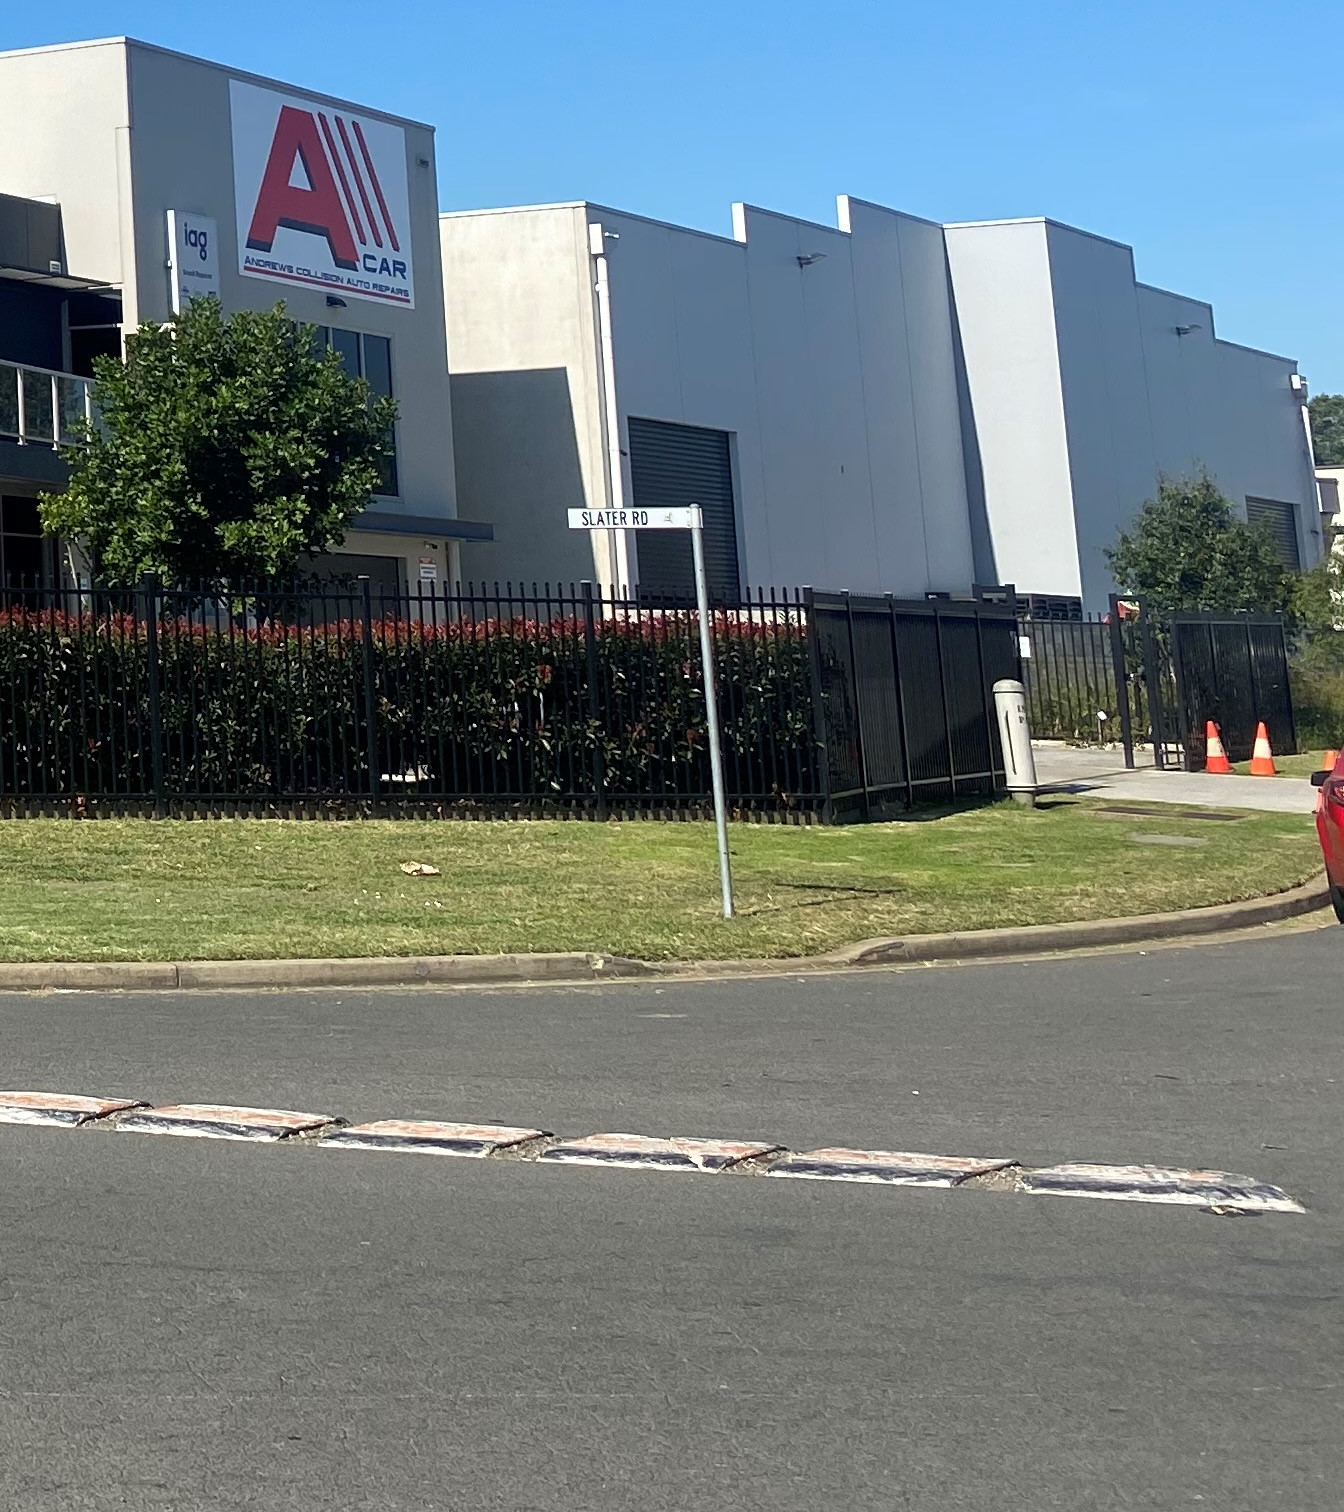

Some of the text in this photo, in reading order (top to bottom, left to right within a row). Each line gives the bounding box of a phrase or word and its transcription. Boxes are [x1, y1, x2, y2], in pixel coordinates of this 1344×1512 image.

[184, 222, 208, 262] iag
[244, 255, 410, 298] ANDREWS COLLISION AUTO REPAIRS
[363, 253, 407, 280] CAR
[581, 510, 649, 526] SLATER RD
